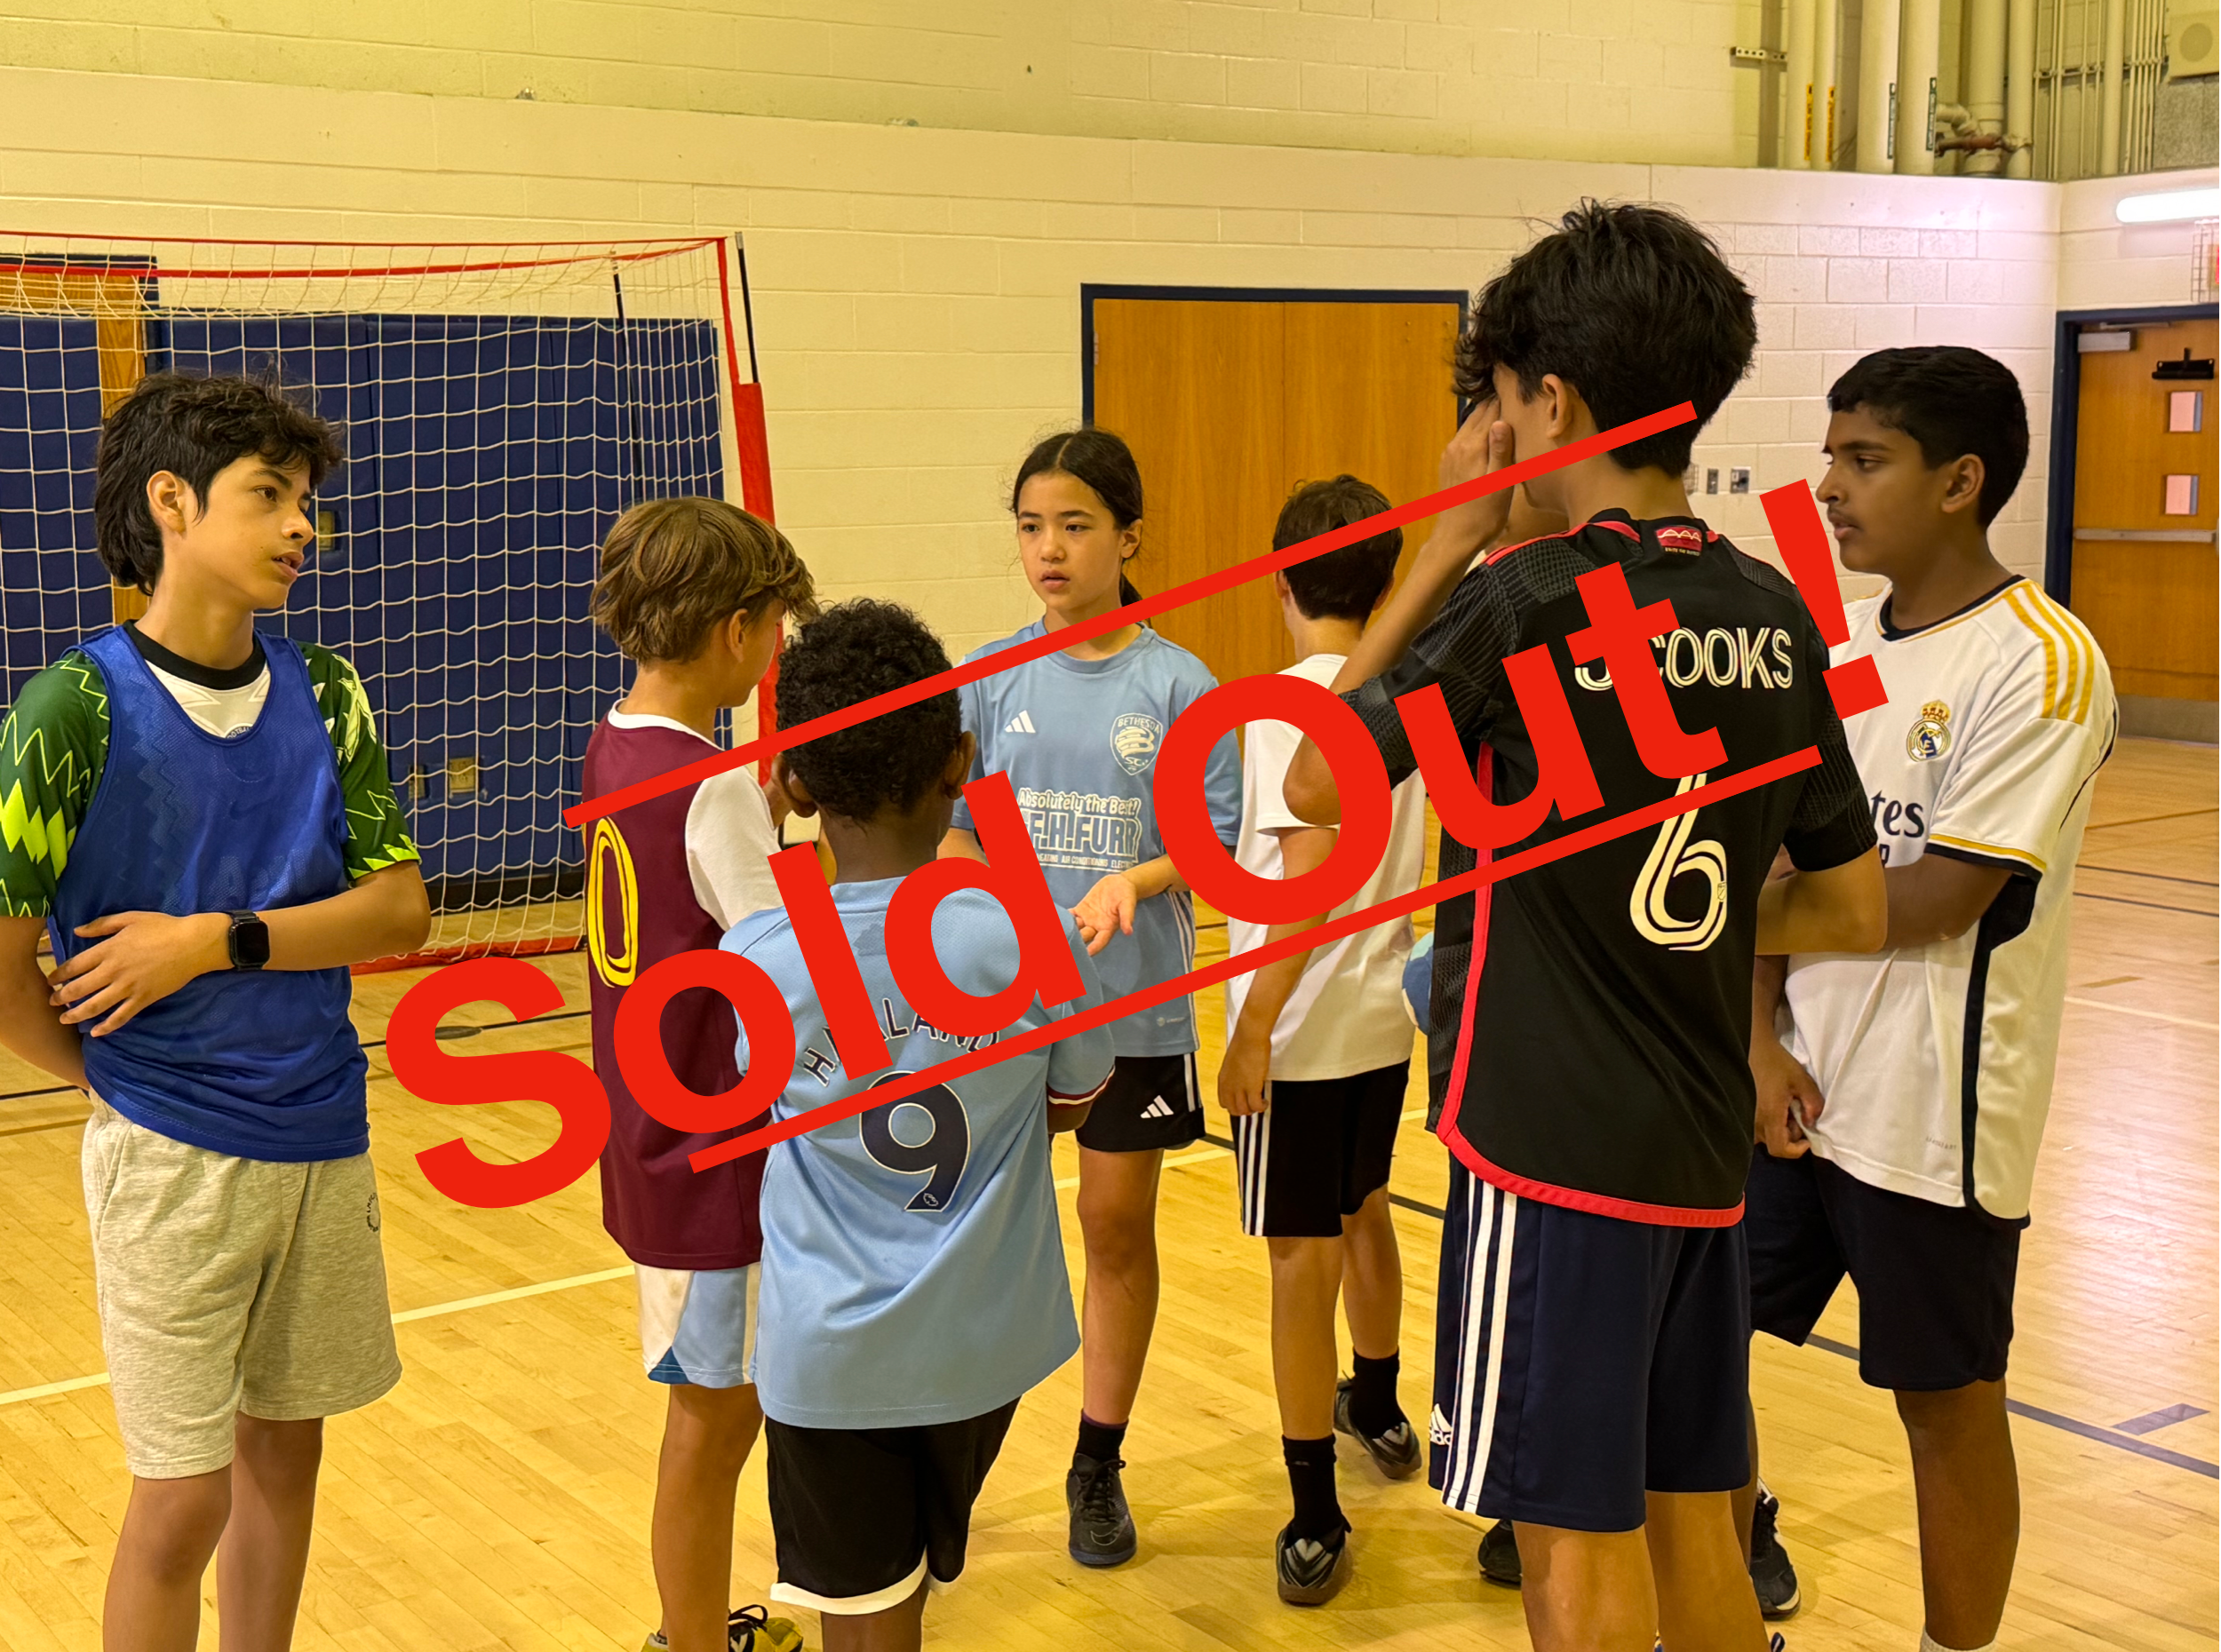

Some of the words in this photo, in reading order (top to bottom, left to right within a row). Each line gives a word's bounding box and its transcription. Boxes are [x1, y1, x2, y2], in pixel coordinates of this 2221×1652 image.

[1118, 717, 1159, 734] BETHESDA
[1018, 789, 1083, 813] Absolutely
[1086, 795, 1107, 813] the
[1110, 798, 1138, 815] Best!
[1629, 773, 1727, 951] 6
[859, 1070, 971, 1212] 9
